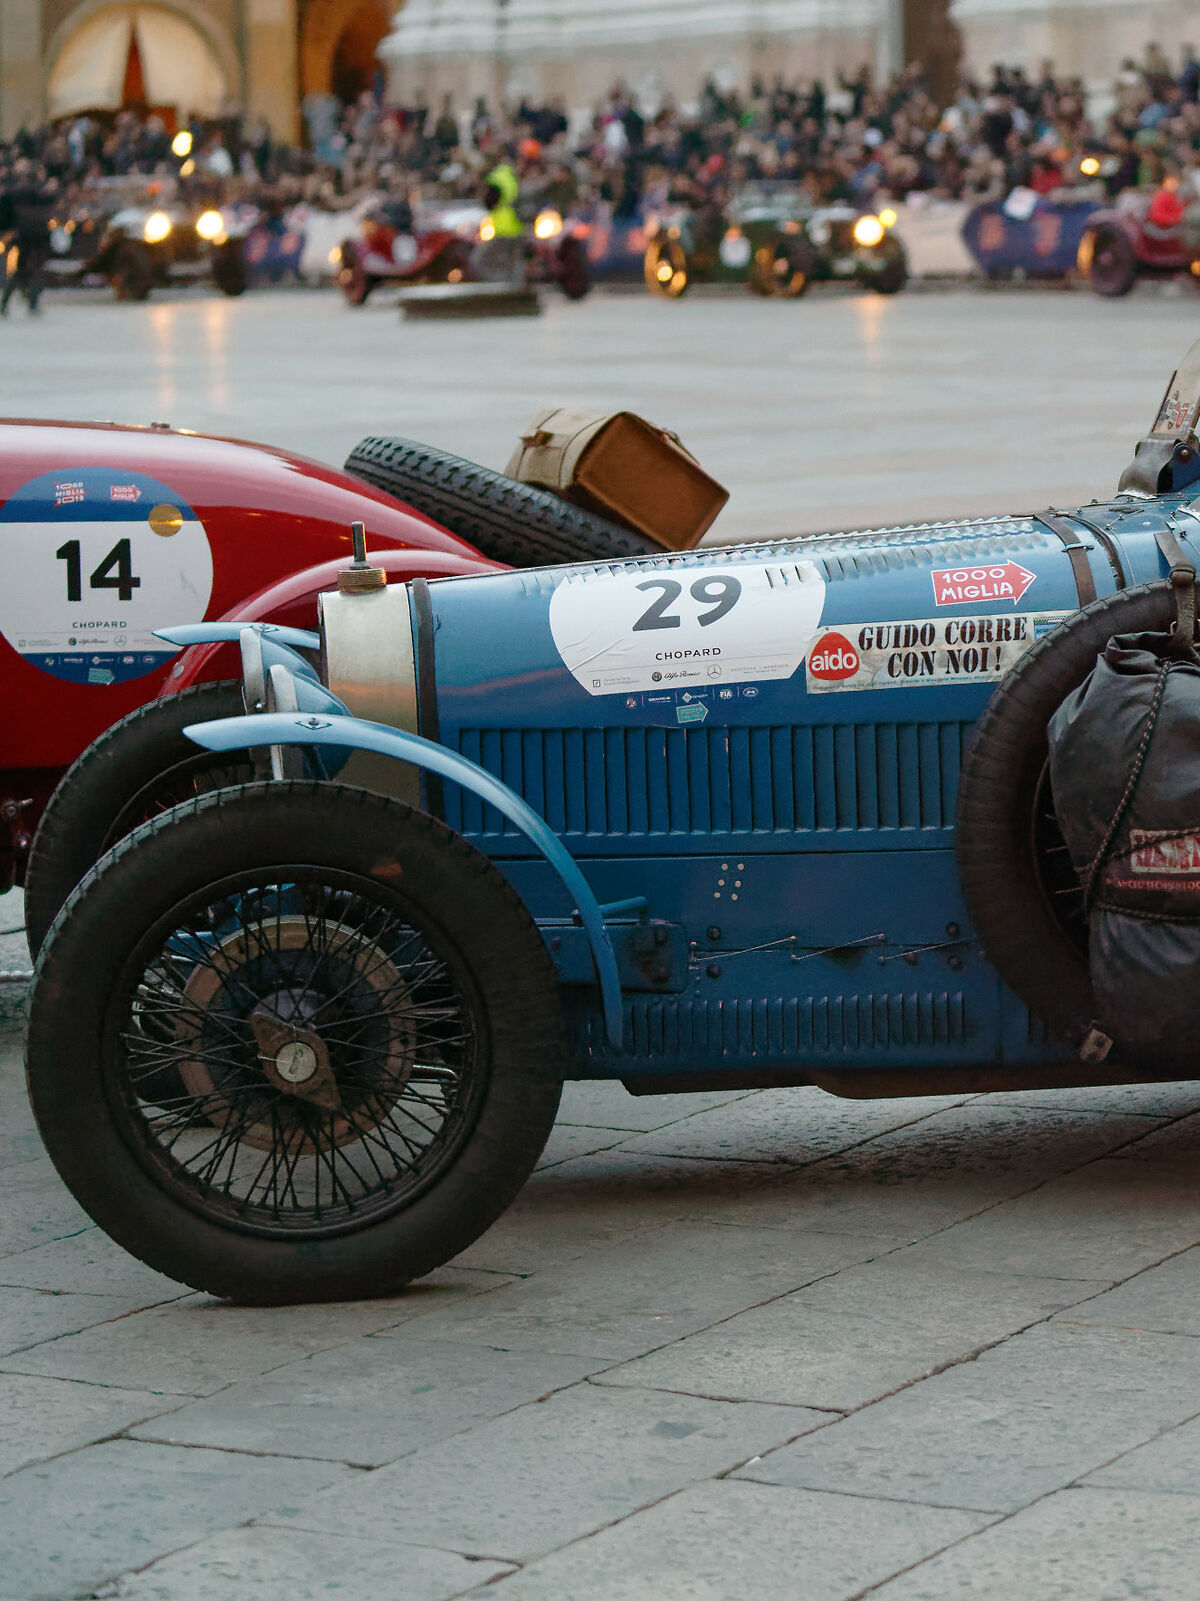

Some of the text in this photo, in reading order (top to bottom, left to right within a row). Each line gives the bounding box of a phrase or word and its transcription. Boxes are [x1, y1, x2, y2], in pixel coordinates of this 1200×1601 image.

[56, 488, 85, 497] MIGLIA
[56, 538, 141, 602] 14
[942, 568, 1006, 584] 1000
[941, 582, 1014, 601] MIGLIA
[632, 575, 742, 632] 29
[72, 621, 128, 629] CHOPARD
[858, 623, 936, 650] GUIDO
[945, 616, 1028, 645] CORRE
[655, 648, 721, 661] CHOPARD
[811, 648, 857, 671] aido
[887, 646, 1002, 678] CON NOI!
